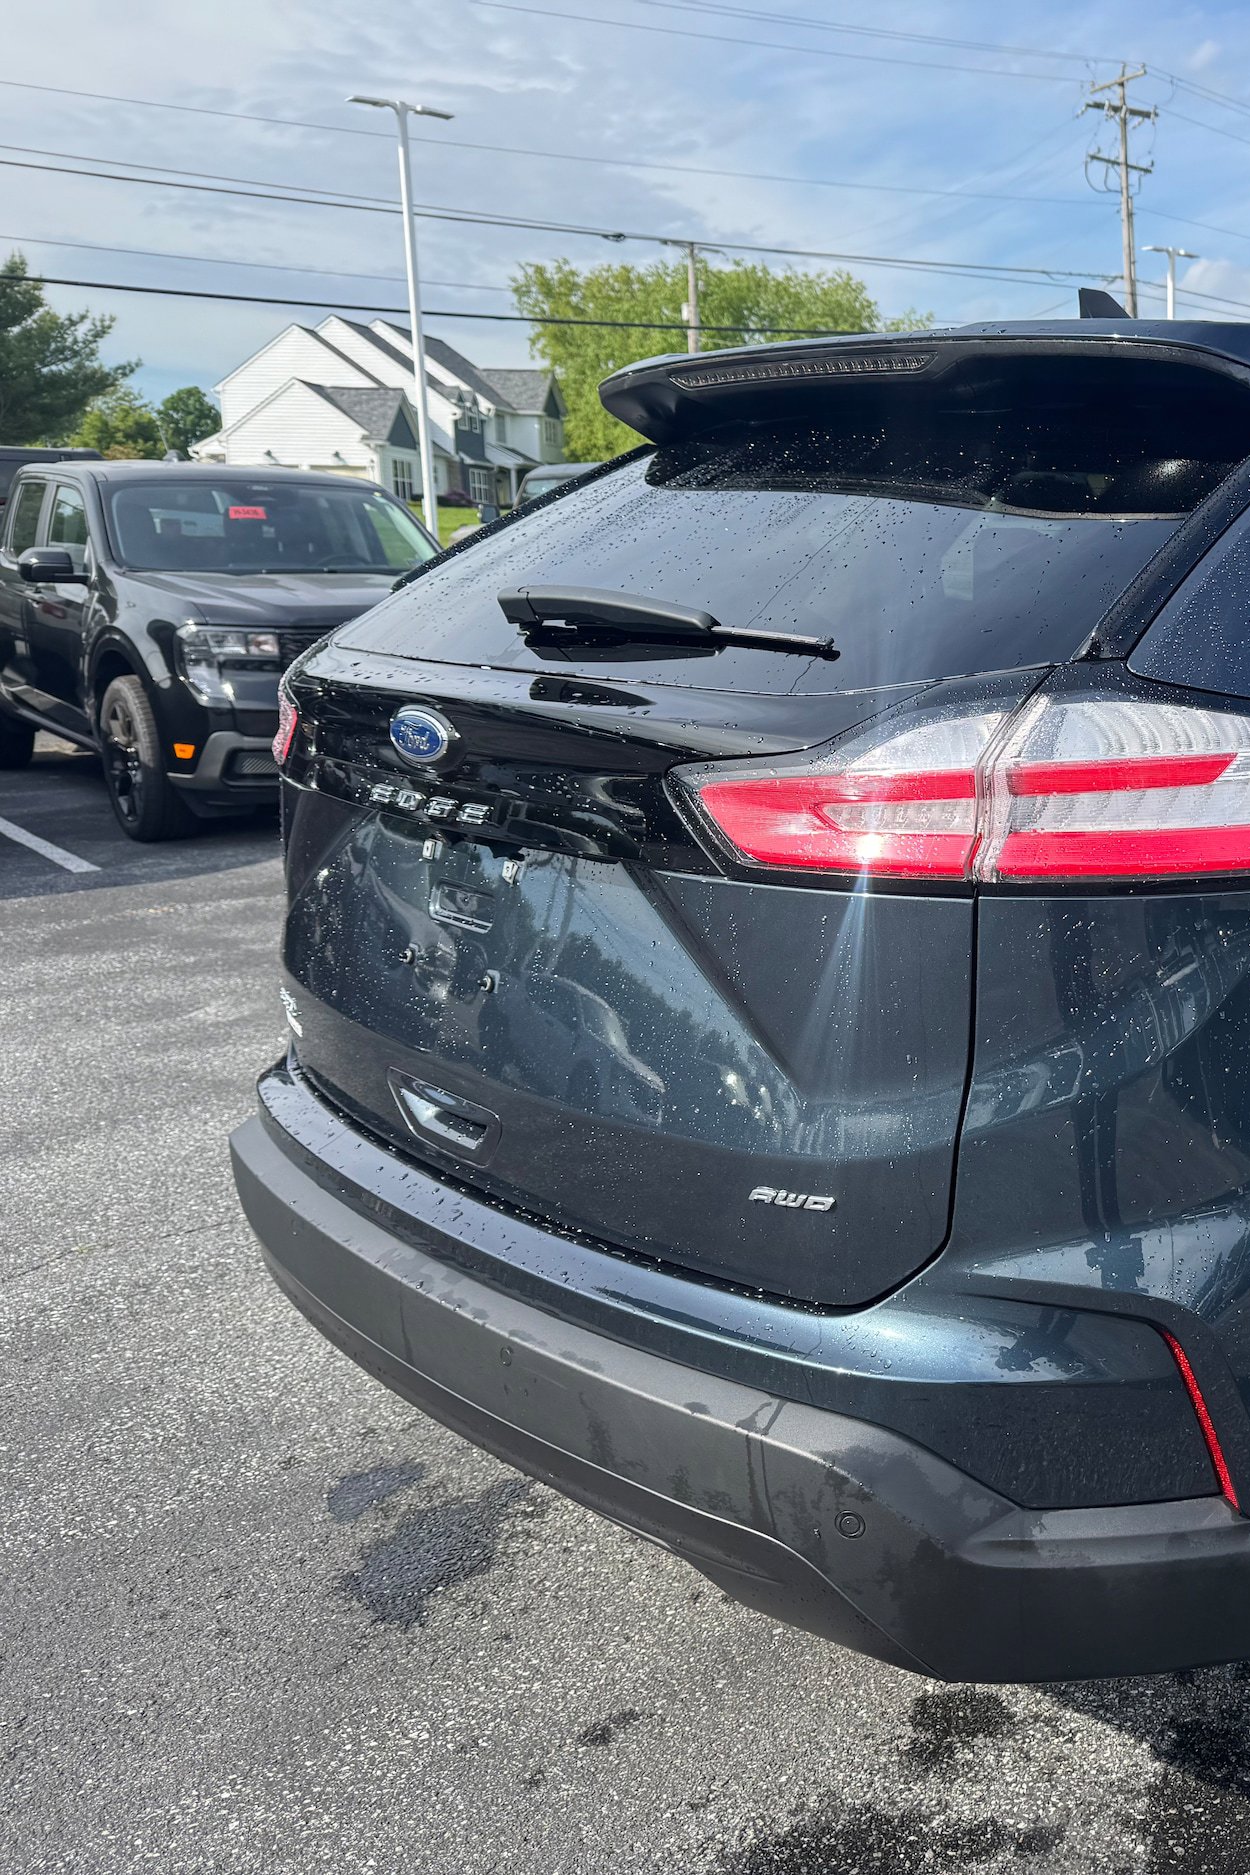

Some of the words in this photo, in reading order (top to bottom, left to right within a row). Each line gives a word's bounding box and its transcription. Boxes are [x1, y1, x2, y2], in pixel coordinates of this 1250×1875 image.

[397, 718, 433, 752] Ford
[370, 783, 492, 825] EDGE
[748, 1185, 837, 1213] AWD
